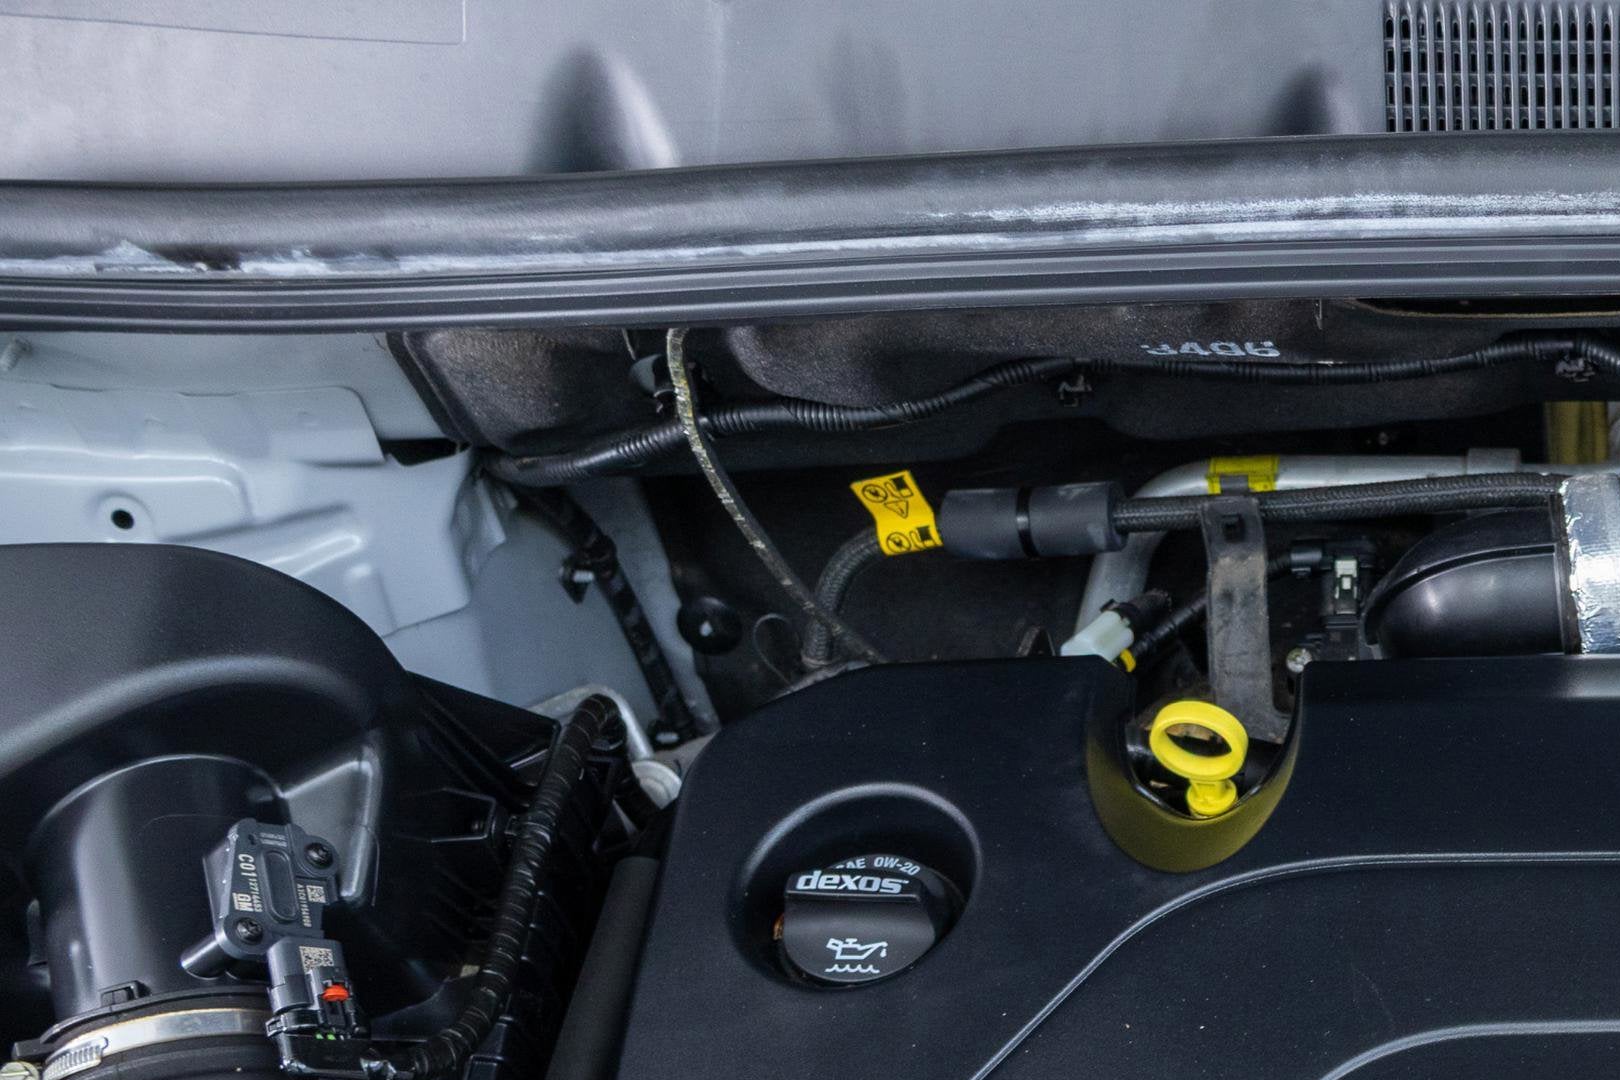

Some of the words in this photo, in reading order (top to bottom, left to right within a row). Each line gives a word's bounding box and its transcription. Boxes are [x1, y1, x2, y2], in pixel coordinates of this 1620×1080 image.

[836, 857, 867, 869] AE
[873, 856, 920, 876] 0W-20
[796, 870, 903, 893] dexos
